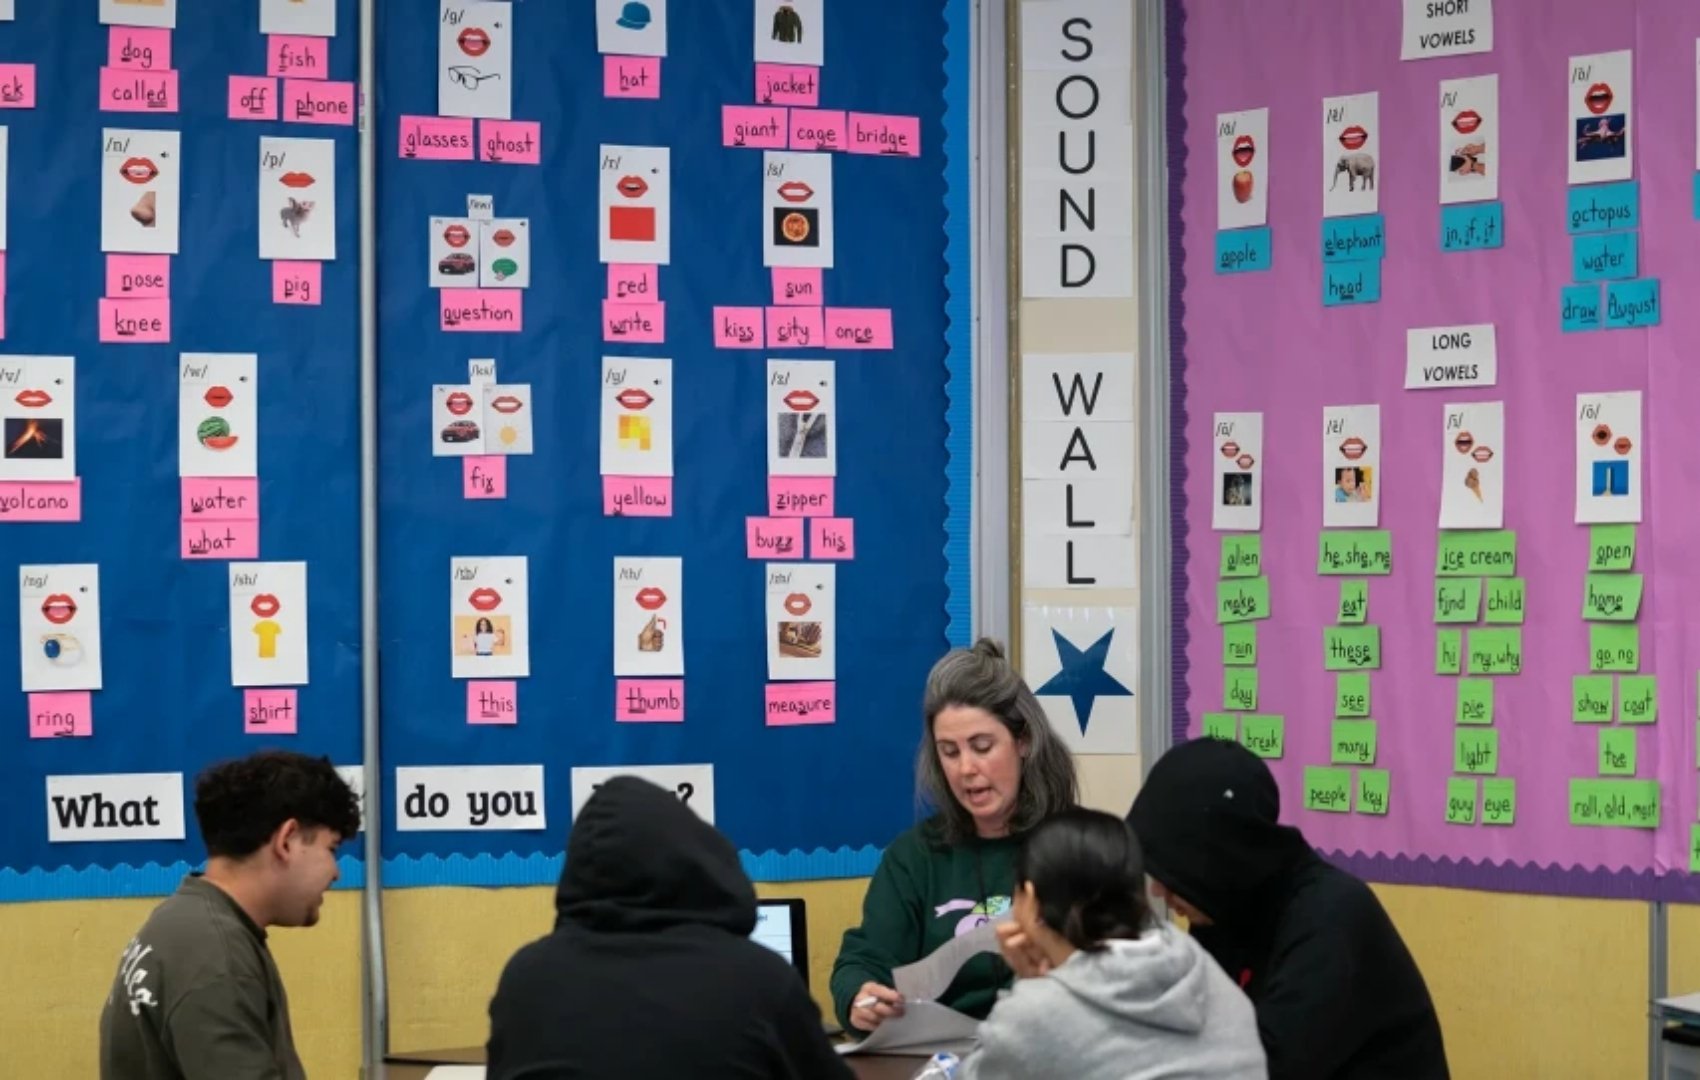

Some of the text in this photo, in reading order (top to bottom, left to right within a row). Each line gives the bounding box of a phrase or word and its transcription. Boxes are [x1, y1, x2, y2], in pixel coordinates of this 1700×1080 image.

[1426, 0, 1469, 18] SHORT
[1419, 29, 1476, 49] VOWELS
[121, 38, 153, 68] dog
[278, 45, 316, 70] fish
[619, 66, 648, 88] hat
[766, 74, 815, 102] jacket
[111, 80, 167, 103] called
[240, 88, 267, 110] off
[295, 91, 348, 116] phone
[406, 126, 469, 153] glasses
[734, 117, 779, 143] giant
[796, 127, 836, 149] cage
[856, 124, 908, 152] bridge
[105, 137, 130, 153] /n/
[486, 132, 534, 158] ghost
[262, 151, 286, 169] /p/
[766, 163, 784, 177] /s/
[1571, 199, 1631, 228] octopus
[1324, 225, 1382, 252] elephant
[1221, 242, 1257, 268] apple
[1582, 245, 1625, 271] water
[122, 273, 164, 290] nose
[284, 275, 311, 301] pig
[617, 273, 648, 295] red
[785, 280, 813, 296] sun
[1328, 272, 1363, 298] head
[443, 299, 514, 323] question
[1051, 17, 1104, 585] SOUND WALL
[1561, 296, 1598, 322] draw
[1606, 291, 1656, 324] August
[114, 308, 162, 333] knee
[609, 312, 653, 334] write
[724, 316, 754, 340] kiss
[777, 316, 810, 345] city
[835, 325, 874, 341] once
[1432, 332, 1472, 351] LONG
[183, 364, 208, 379] /w/
[1422, 364, 1479, 382] VOWELS
[470, 466, 495, 492] fix
[190, 487, 247, 511] water
[613, 486, 667, 513] yellow
[776, 490, 828, 511] zipper
[189, 528, 237, 551] what
[755, 527, 793, 550] buzz
[822, 527, 846, 550] his
[1227, 543, 1259, 568] alien
[1444, 548, 1514, 569] ice cream
[1596, 544, 1632, 566] open
[232, 572, 259, 587] /sh/
[619, 567, 642, 581] /th/
[1223, 588, 1257, 613] make
[1342, 589, 1366, 614] eat
[1438, 586, 1466, 613] find
[1488, 588, 1522, 611] child
[1588, 584, 1623, 610] home
[1229, 641, 1253, 657] rain
[1331, 637, 1371, 662] these
[1442, 641, 1457, 666] hi
[1617, 649, 1634, 664] no
[479, 690, 514, 714] this
[625, 687, 681, 711] thumb
[1231, 679, 1253, 708] day
[1341, 694, 1365, 710] see
[1578, 693, 1608, 713] show
[1623, 689, 1652, 714] coat
[249, 697, 292, 720] shirt
[768, 698, 832, 714] measure
[1462, 700, 1485, 719] pie
[36, 709, 75, 734] ring
[1245, 726, 1279, 750] break
[1337, 738, 1369, 762] many
[1460, 741, 1491, 771] light
[1603, 742, 1627, 768] toe
[52, 784, 537, 829] What do you
[1310, 784, 1346, 808] people
[1362, 781, 1383, 812] key
[1449, 797, 1474, 822] guy
[1484, 797, 1512, 820] eye
